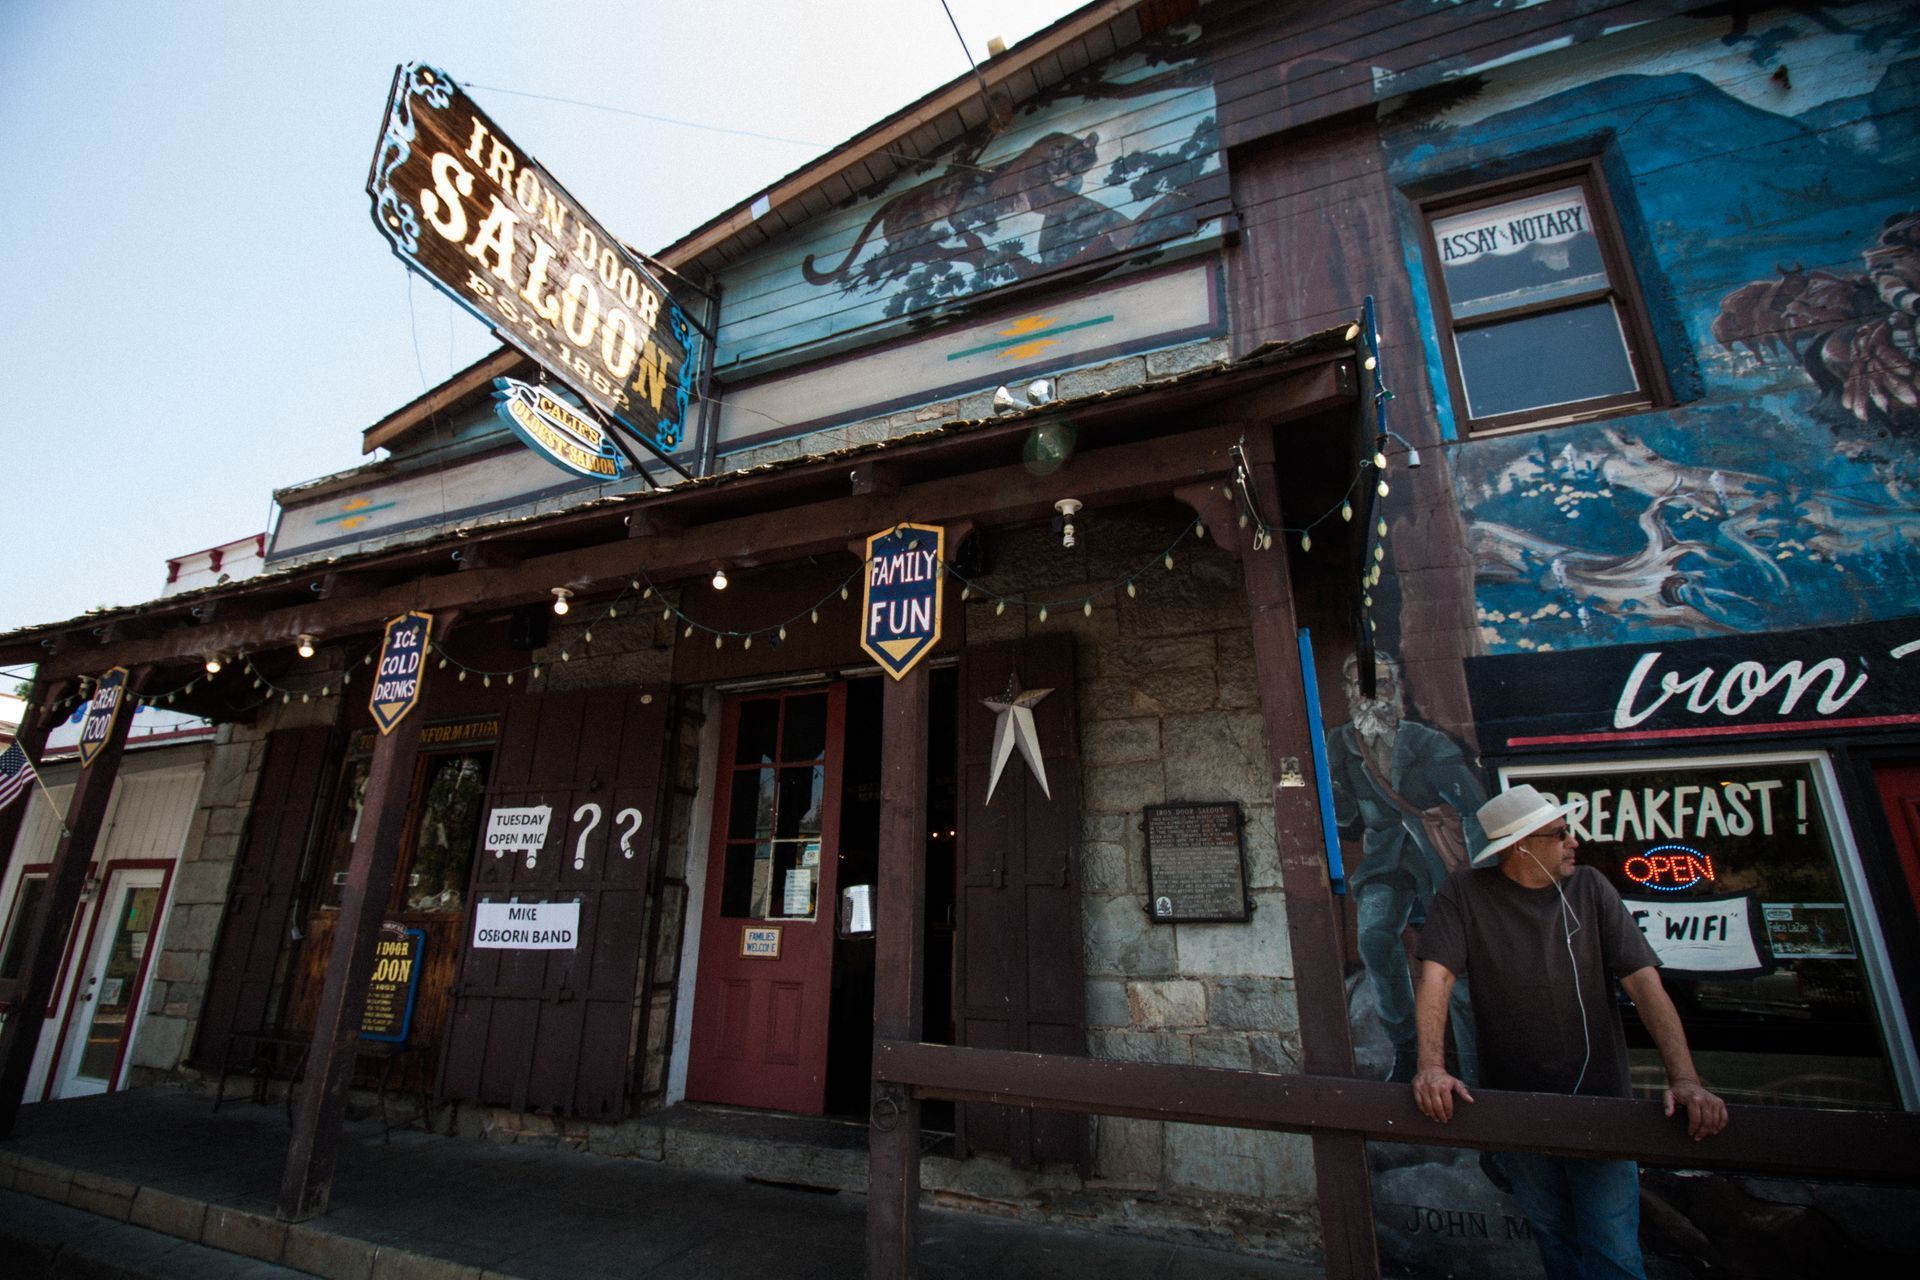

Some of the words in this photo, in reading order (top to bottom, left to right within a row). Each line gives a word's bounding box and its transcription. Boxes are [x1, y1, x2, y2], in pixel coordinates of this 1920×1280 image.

[464, 115, 567, 240] IRON
[575, 219, 660, 332] DOOR
[1442, 226, 1499, 261] ASSAY
[1507, 206, 1584, 246] NOTARY
[420, 151, 672, 415] SALOON
[465, 269, 554, 351] EST.
[557, 344, 630, 411] 1852
[871, 549, 937, 587] FAMILY
[870, 597, 931, 636] FUN
[392, 629, 418, 649] ICE
[379, 650, 419, 677] COLD
[92, 686, 120, 711] GREAT
[374, 678, 418, 701] DRINKS
[83, 713, 112, 741] FOOD
[420, 721, 499, 743] NFORMATION
[496, 814, 546, 826] TUESDAY
[488, 833, 519, 845] OPEN
[521, 832, 545, 844] MIC
[1623, 854, 1716, 883] OPEN
[508, 907, 538, 921] MIKE
[381, 941, 410, 956] DOOR
[478, 928, 529, 943] OSBORN
[532, 929, 572, 944] BAND
[371, 958, 412, 984] OON
[1407, 1205, 1489, 1238] JOHN
